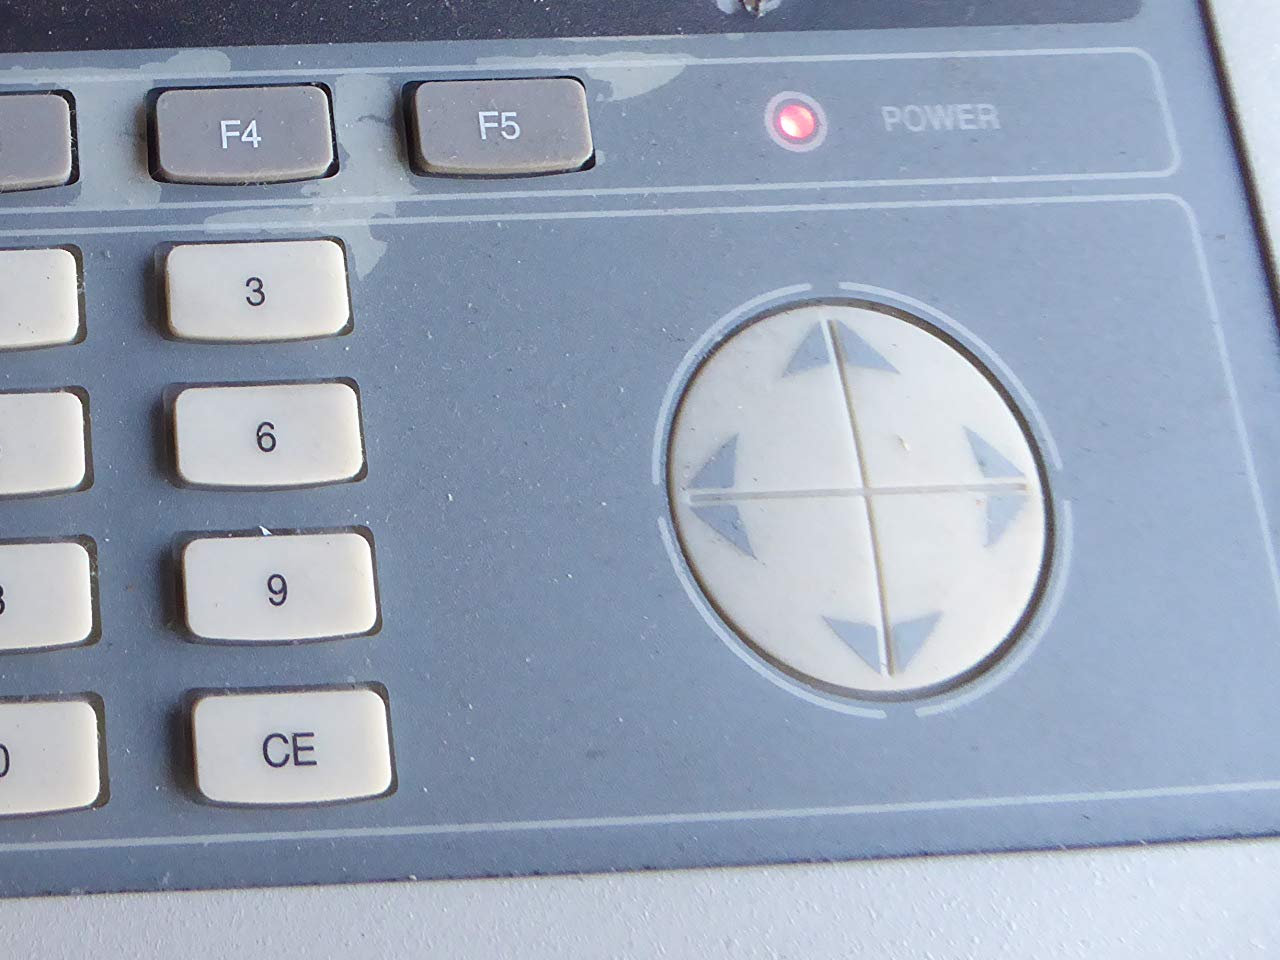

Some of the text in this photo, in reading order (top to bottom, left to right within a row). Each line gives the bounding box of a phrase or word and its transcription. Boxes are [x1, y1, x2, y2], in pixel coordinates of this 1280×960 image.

[477, 110, 522, 140] F5
[882, 103, 1000, 132] POWER
[220, 119, 263, 150] F4
[244, 276, 266, 307] 3
[255, 422, 277, 453] 6
[266, 574, 289, 607] 9
[261, 732, 317, 768] CE
